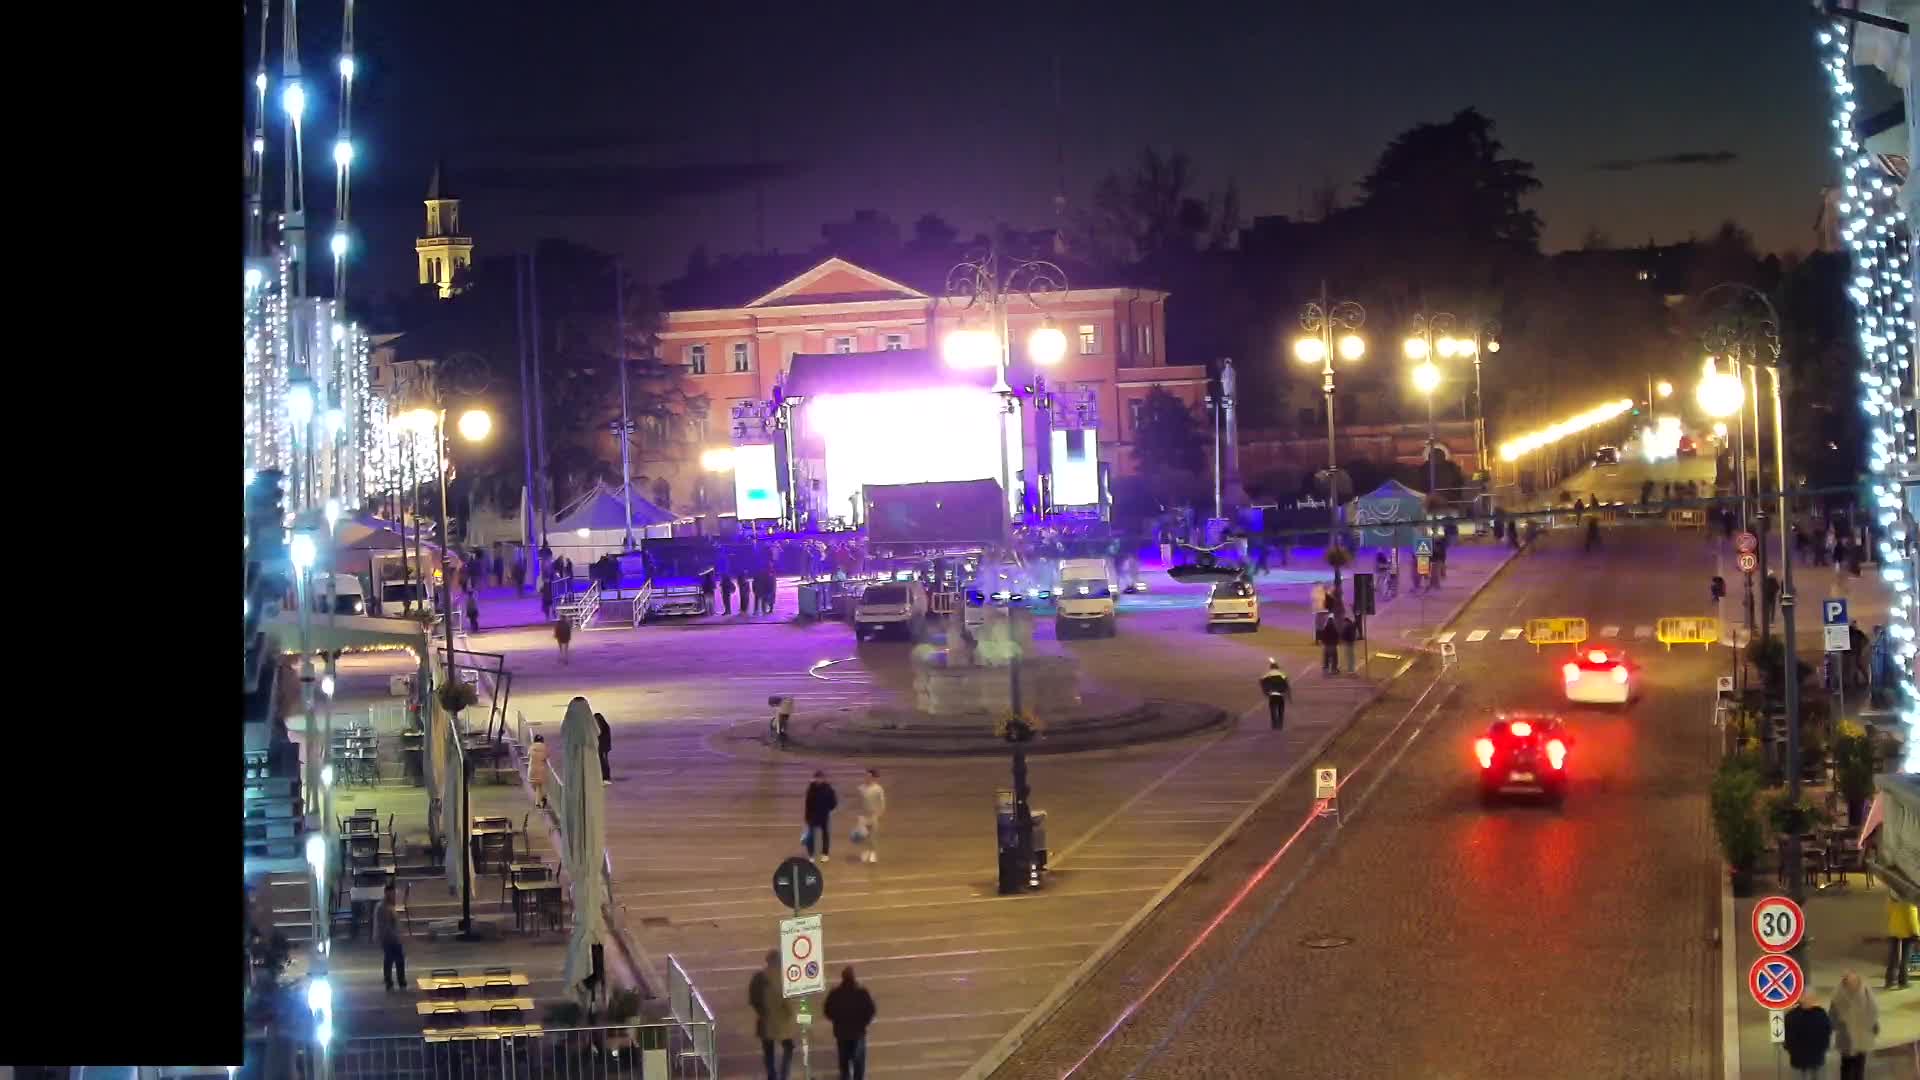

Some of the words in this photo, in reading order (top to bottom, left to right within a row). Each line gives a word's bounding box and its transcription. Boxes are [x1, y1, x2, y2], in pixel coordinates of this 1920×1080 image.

[1743, 557, 1753, 567] 20
[1827, 602, 1842, 622] P
[1762, 911, 1792, 938] 30
